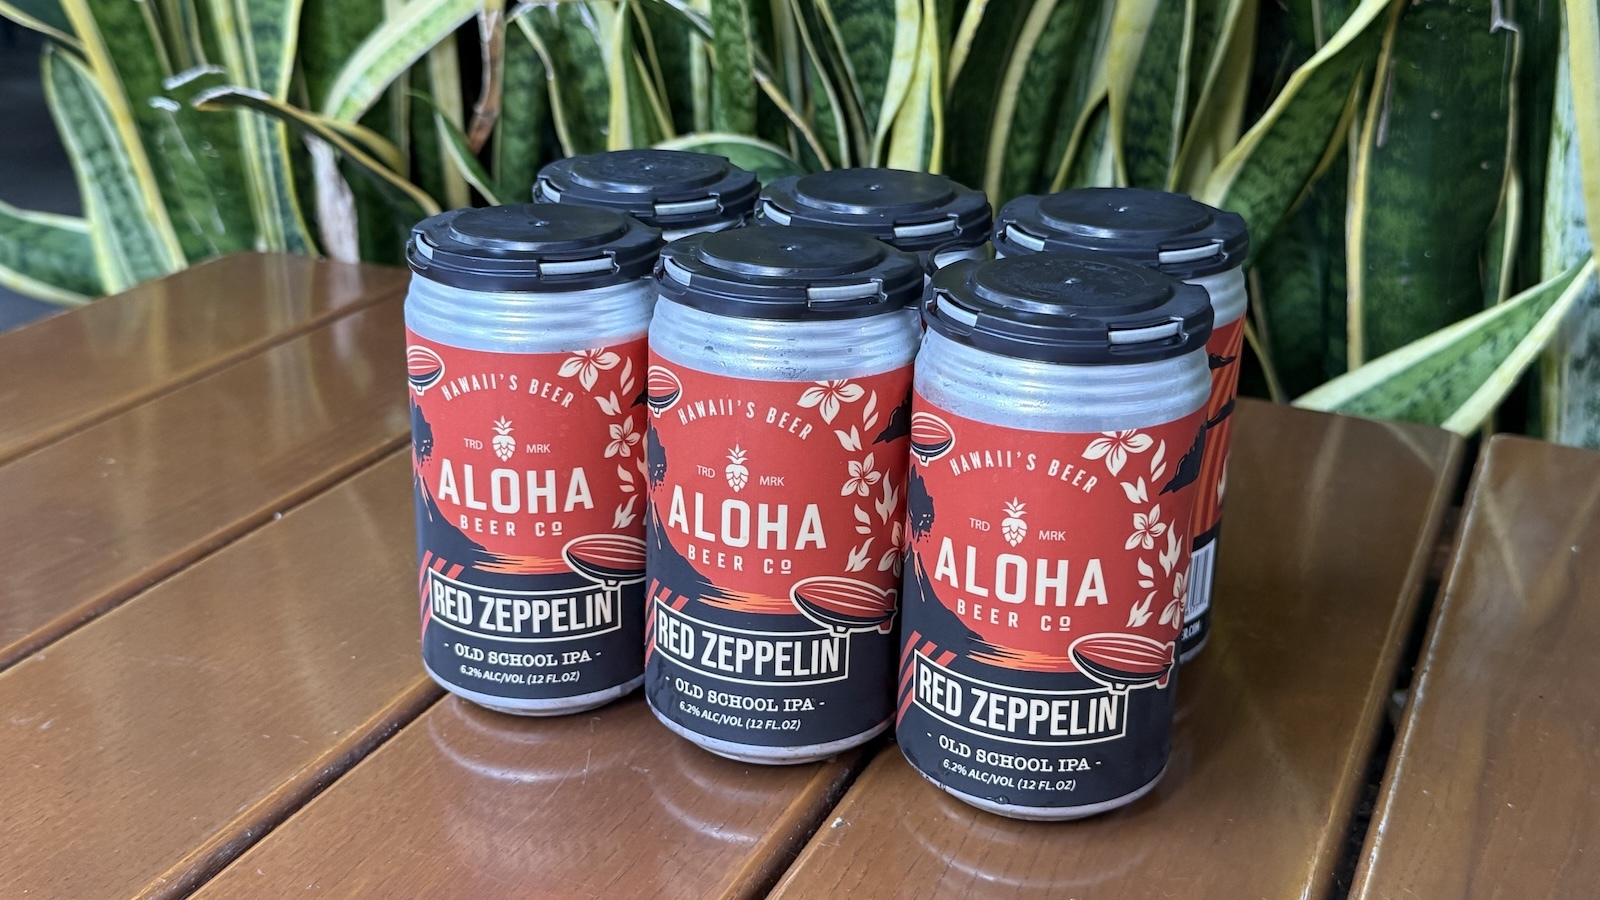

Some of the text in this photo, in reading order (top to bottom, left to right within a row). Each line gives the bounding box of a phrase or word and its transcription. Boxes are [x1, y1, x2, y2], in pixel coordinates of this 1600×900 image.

[441, 373, 575, 408] HAWAII'S BEER
[677, 398, 813, 441] HAWAII'S BEER
[463, 438, 551, 454] TRD MRK
[438, 457, 595, 515] ALOHA
[696, 465, 785, 487] TRD MRK
[950, 450, 1098, 493] HAWAII'S BEER
[460, 514, 516, 537] BEER
[668, 484, 827, 550] ALOHA
[969, 517, 1067, 542] TRD MRK
[687, 544, 744, 572] BEER
[934, 536, 1109, 607] ALOHA
[432, 579, 613, 633] RED ZEPPELIN
[957, 599, 1019, 628] BEER
[454, 642, 485, 662] OLD
[488, 651, 558, 667] SCHOOL
[561, 650, 592, 665] IPA
[658, 609, 840, 677] RED ZEPPELIN
[460, 665, 482, 679] 6.2%
[482, 671, 525, 684] ALC/VOL
[527, 673, 544, 685] (12
[675, 677, 704, 700] OLD
[707, 689, 779, 712] SCHOOL
[782, 698, 815, 711] IPA
[919, 663, 1119, 736] RED ZEPPELIN
[679, 701, 701, 717] 6.2%
[700, 709, 744, 727] ALC/VOL
[745, 717, 763, 730] (12
[938, 735, 971, 758] OLD
[975, 747, 1053, 772] SCHOOL
[1057, 758, 1091, 772] IPA
[942, 759, 967, 776] 6.2%
[967, 767, 1015, 788] ALC/VOL
[1017, 778, 1036, 790] (12
